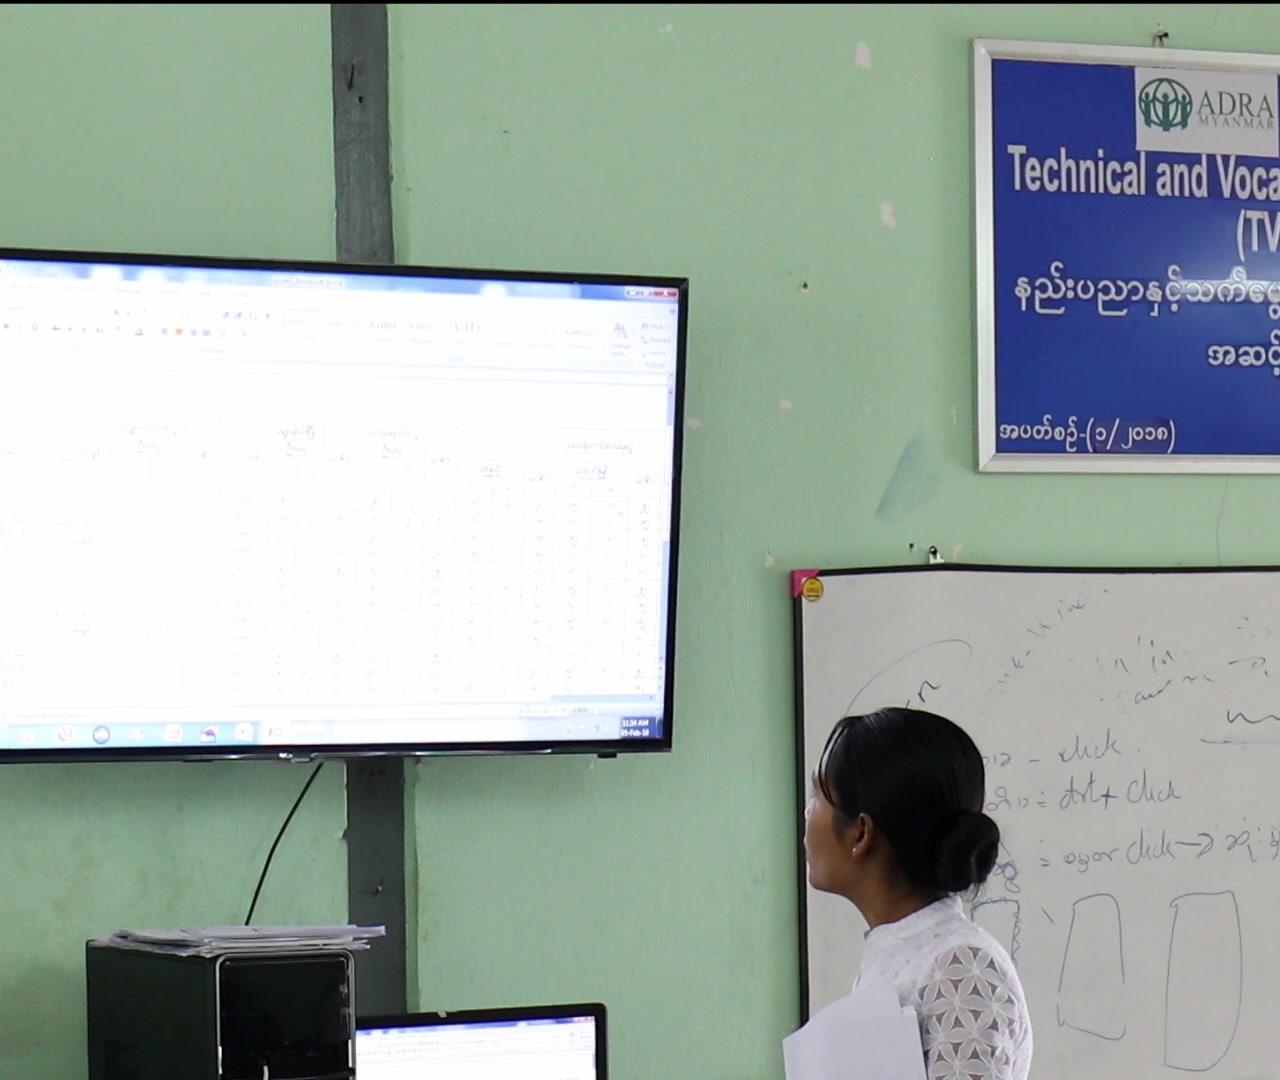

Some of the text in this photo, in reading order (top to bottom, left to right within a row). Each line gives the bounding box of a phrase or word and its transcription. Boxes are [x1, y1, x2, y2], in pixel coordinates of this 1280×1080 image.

[1197, 90, 1275, 119] ADRA
[1198, 114, 1276, 130] MYANMAR
[1007, 144, 1146, 196] Technical
[1156, 153, 1208, 198] and
